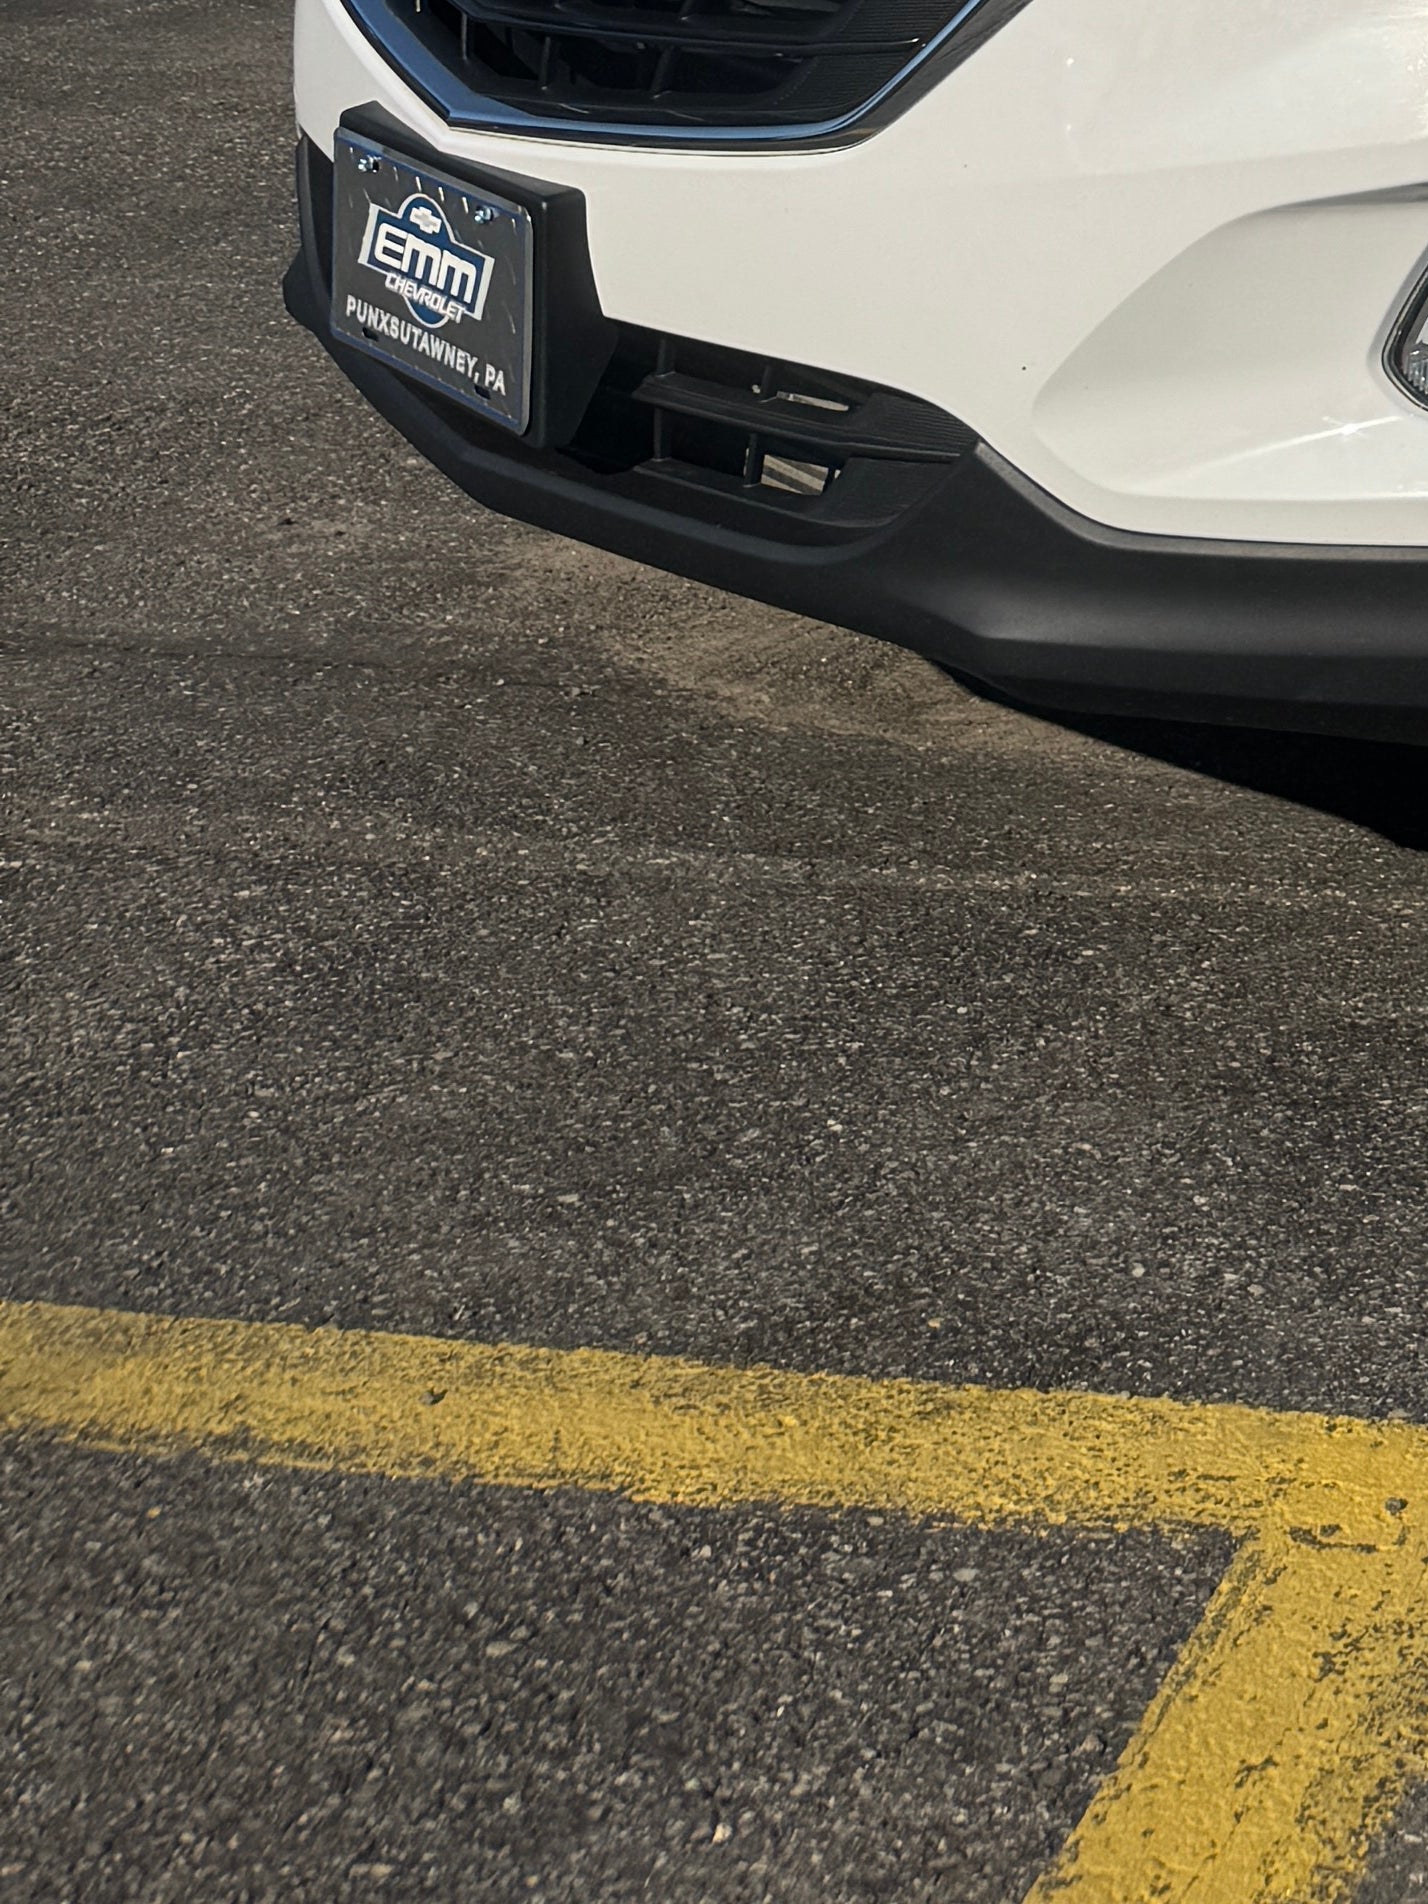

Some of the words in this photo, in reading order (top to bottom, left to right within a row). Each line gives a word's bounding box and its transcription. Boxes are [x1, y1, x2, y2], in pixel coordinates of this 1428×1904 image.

[384, 271, 467, 324] CHEVROLET
[346, 294, 480, 383] PUNXSUTAWNEY,
[484, 364, 507, 397] PA
